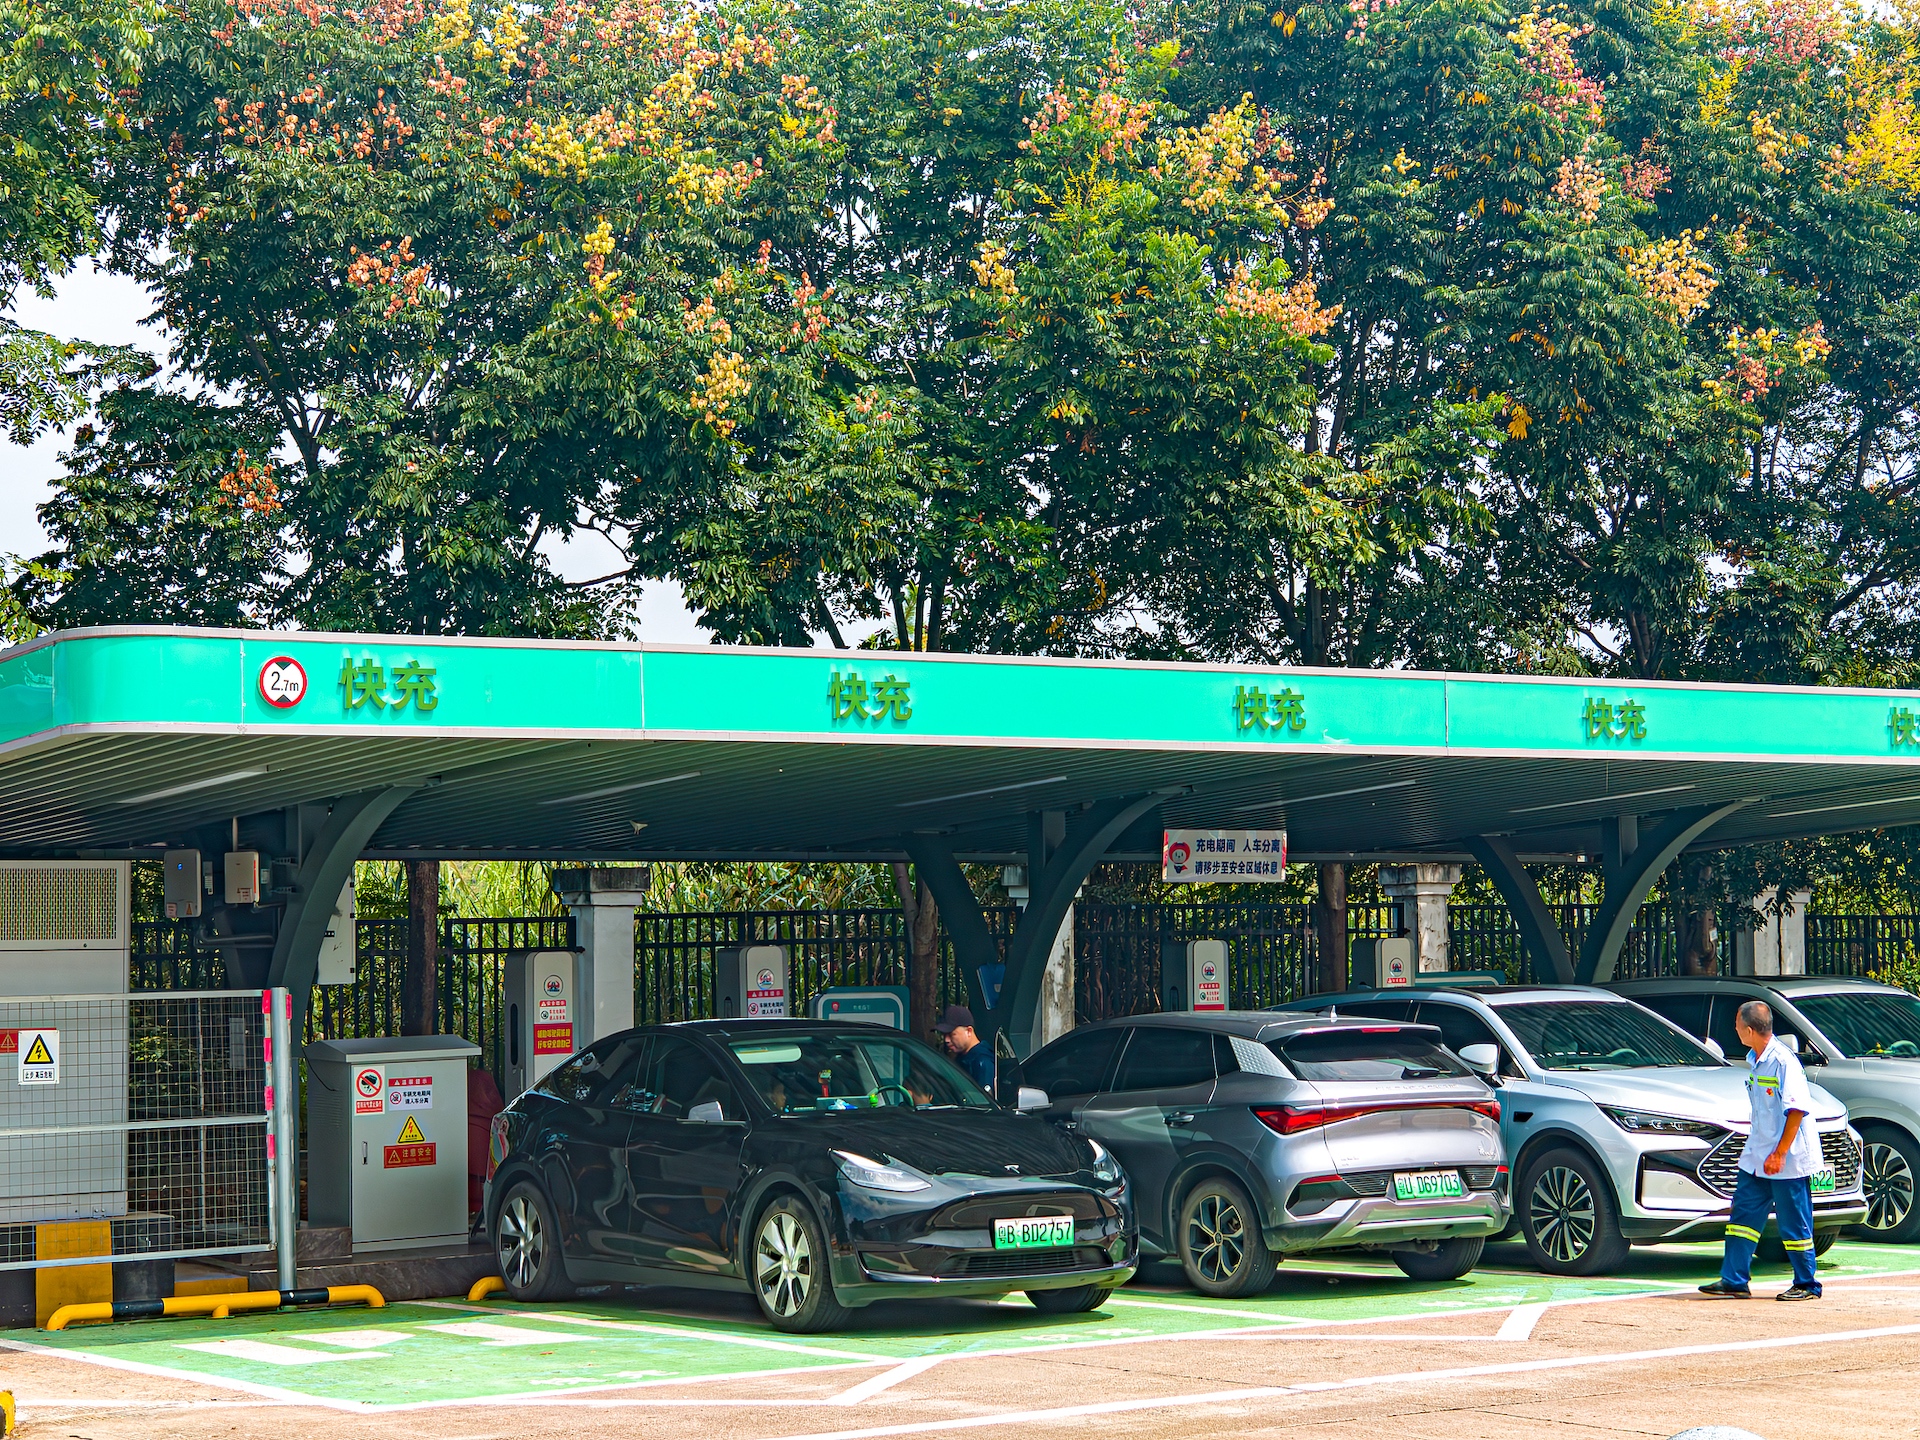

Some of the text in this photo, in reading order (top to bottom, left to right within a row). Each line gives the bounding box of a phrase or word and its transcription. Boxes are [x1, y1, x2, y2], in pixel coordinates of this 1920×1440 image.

[271, 671, 299, 692] 2.7m
[338, 657, 439, 711] 快充
[827, 671, 913, 721] 快充
[1232, 685, 1307, 731] 快充
[1582, 697, 1647, 739] 快充
[1887, 706, 1920, 747] 快
[1196, 839, 1280, 853] 充电期间 人车分离
[1195, 861, 1278, 875] 请移步至安全区域休息
[1810, 1170, 1832, 1187] 622
